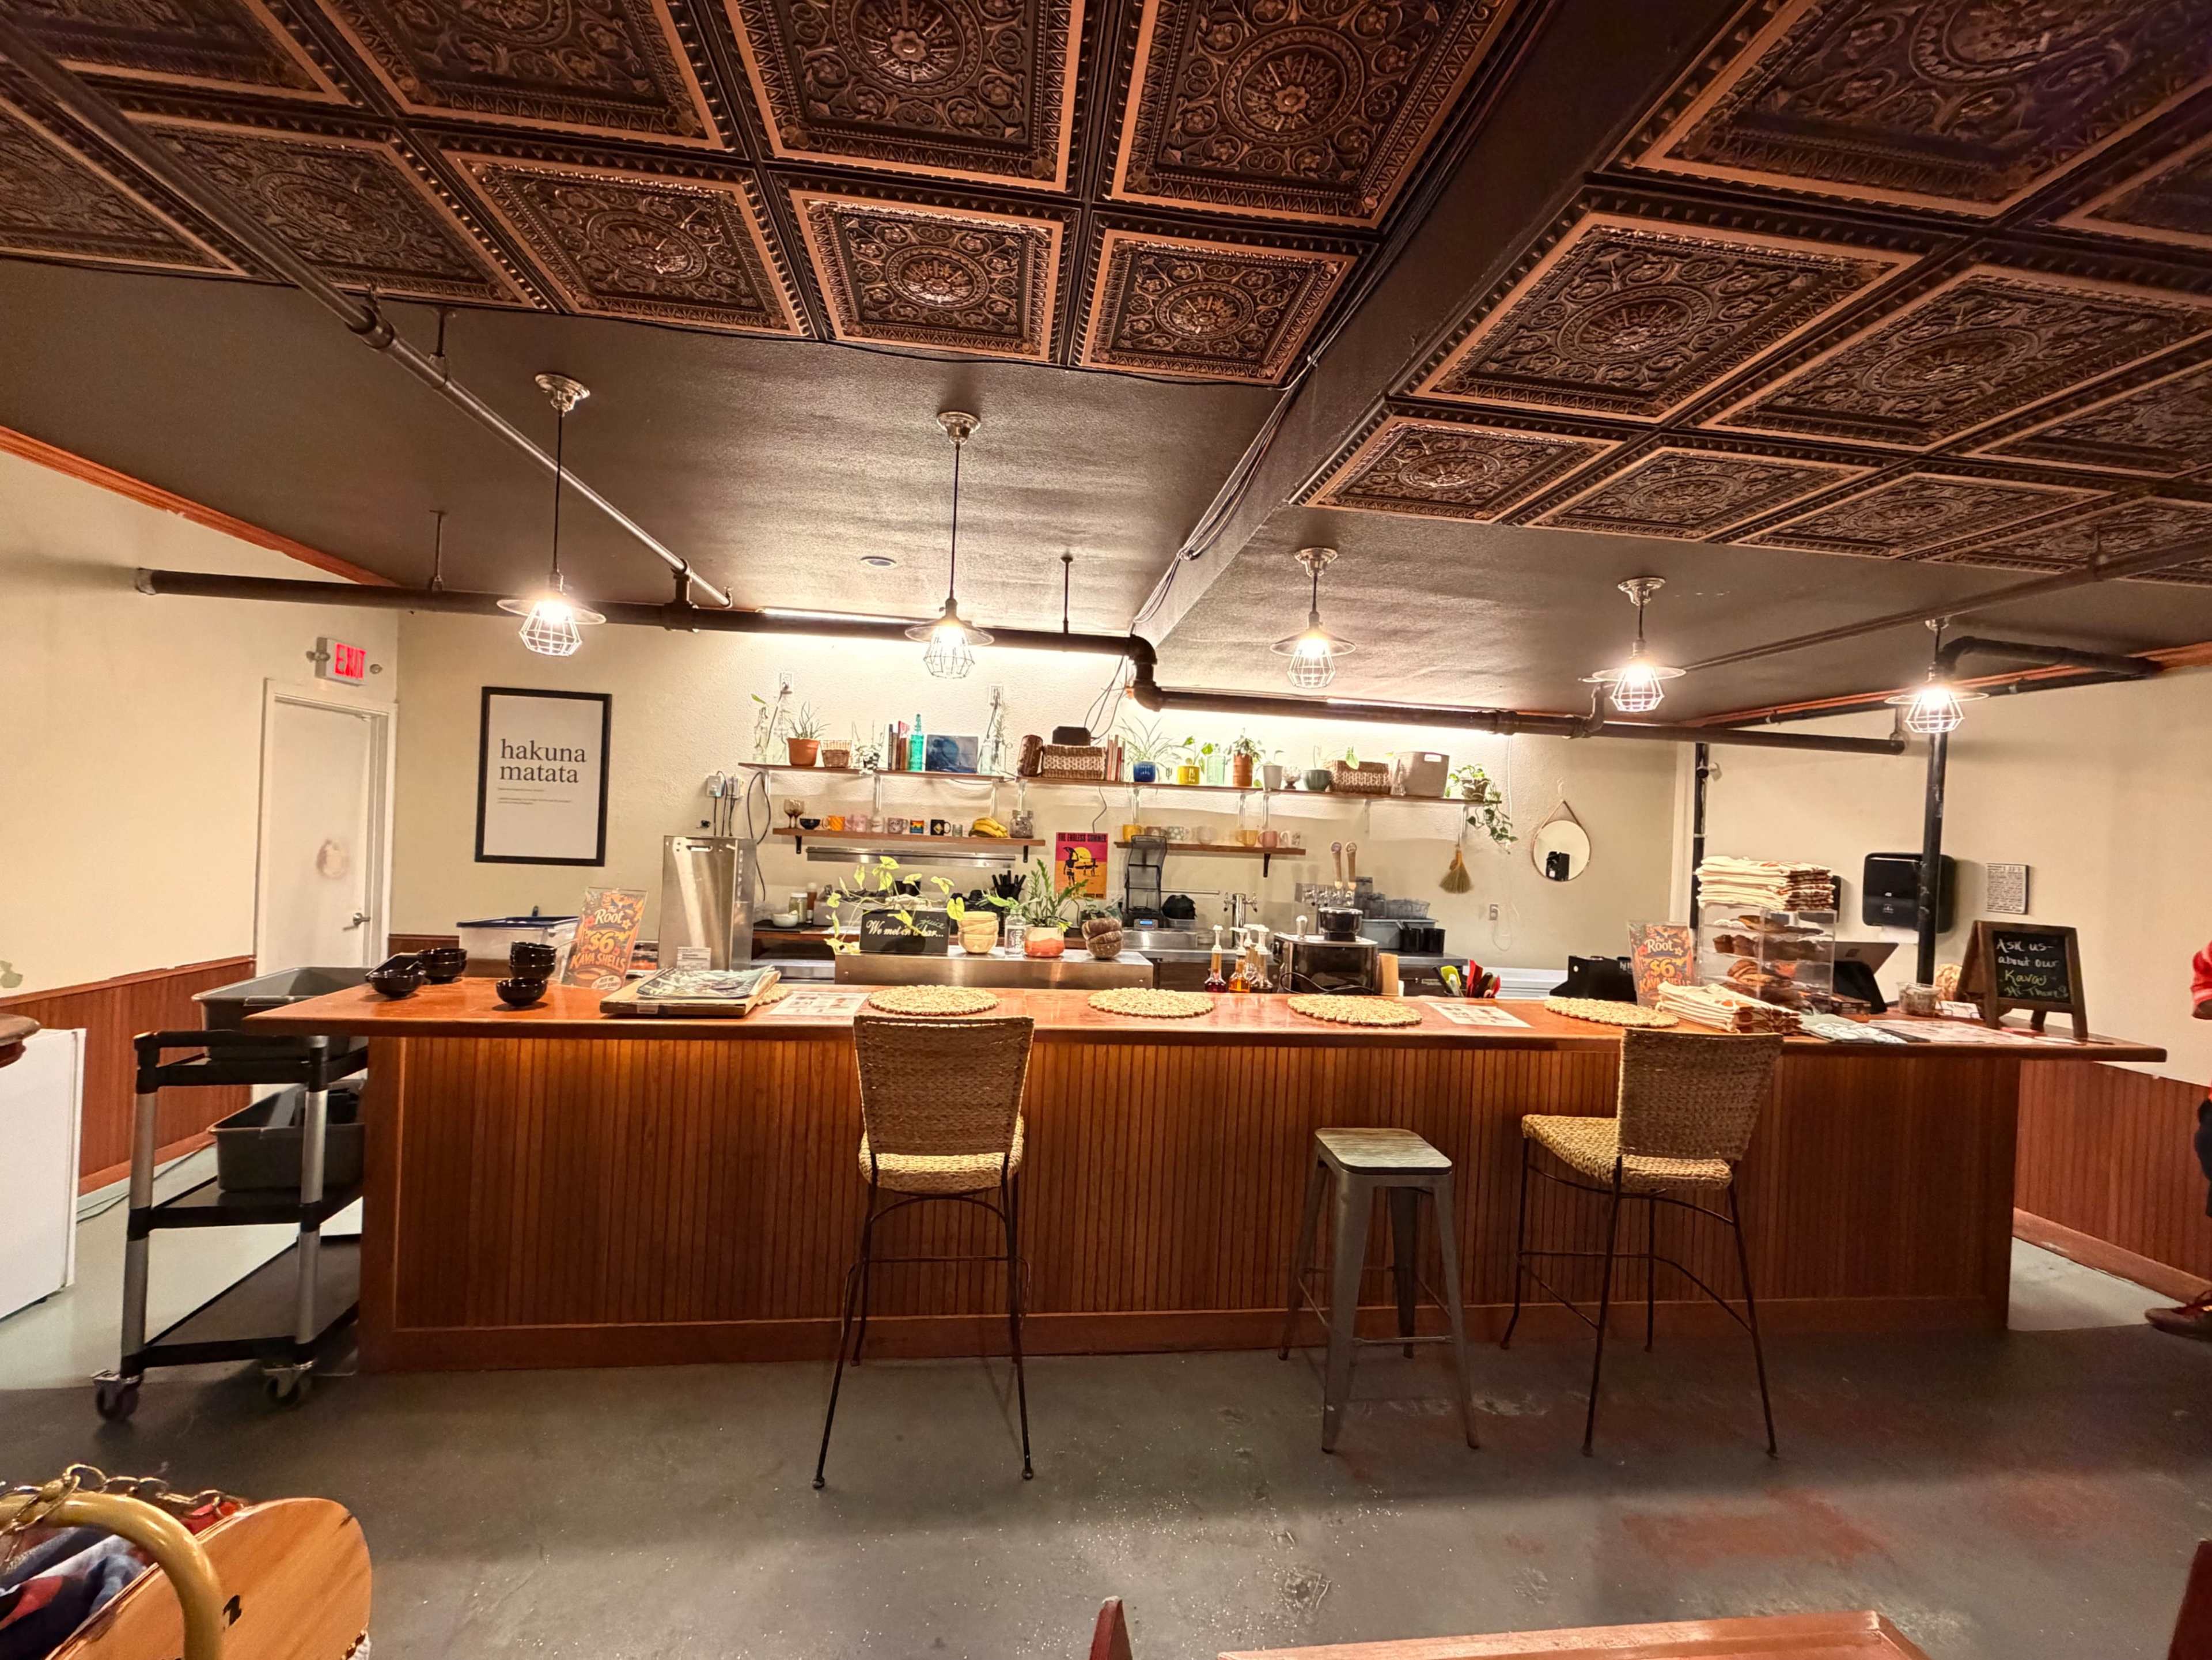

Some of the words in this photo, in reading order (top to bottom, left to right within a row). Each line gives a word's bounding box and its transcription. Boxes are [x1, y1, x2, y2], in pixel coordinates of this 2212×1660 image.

[335, 643, 367, 679] EXIT
[501, 739, 586, 763] hakuna
[499, 765, 579, 783] matata
[594, 909, 624, 925] Root
[916, 916, 945, 929] juice
[866, 920, 885, 935] We
[884, 925, 900, 936] met
[588, 931, 615, 954] $6
[1645, 939, 1674, 954] Root
[570, 952, 595, 969] KAVA
[596, 954, 627, 973] SHELLS
[1650, 959, 1676, 978] $6
